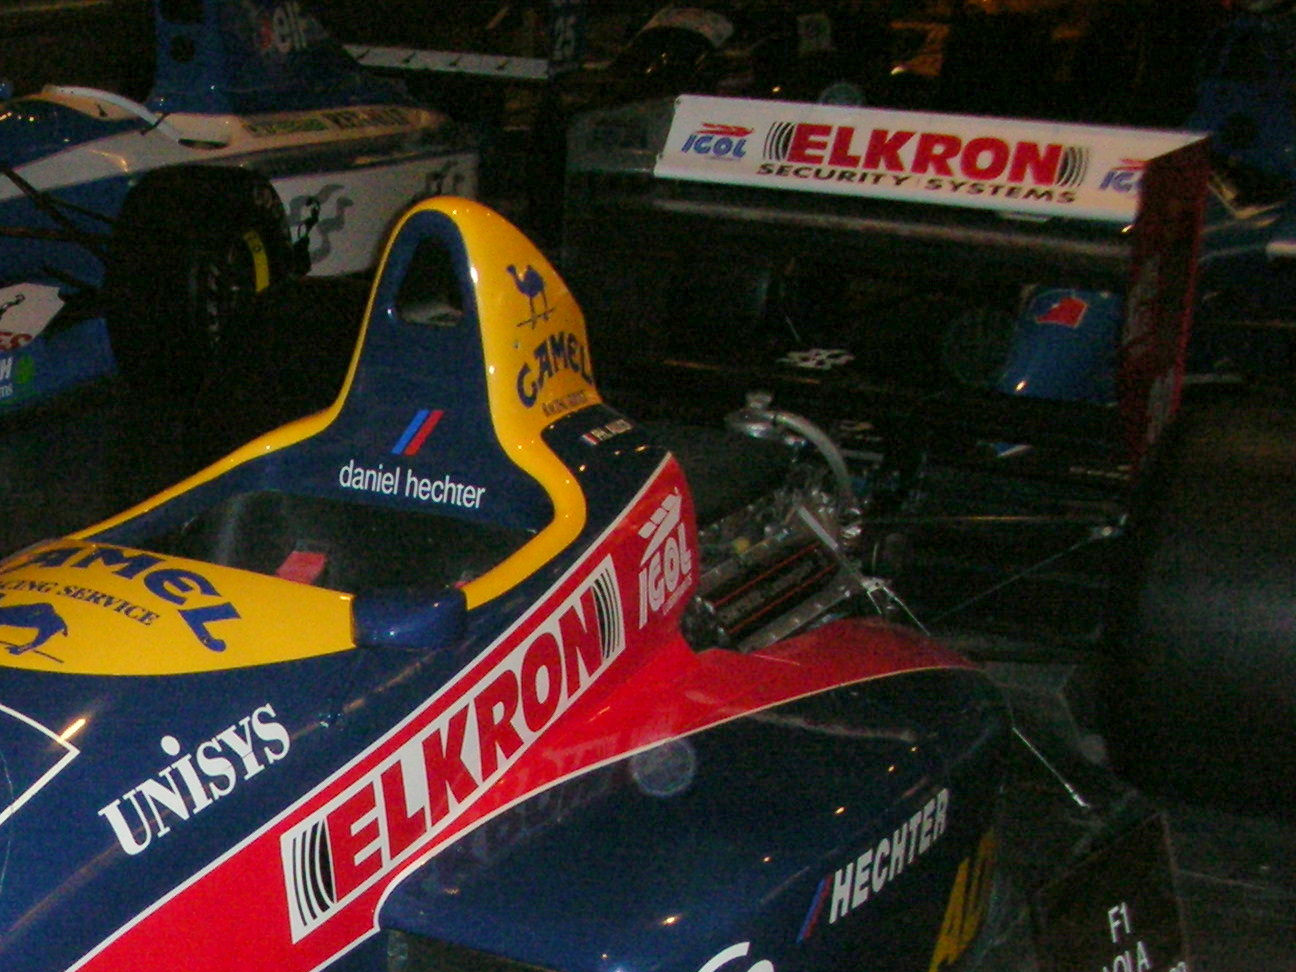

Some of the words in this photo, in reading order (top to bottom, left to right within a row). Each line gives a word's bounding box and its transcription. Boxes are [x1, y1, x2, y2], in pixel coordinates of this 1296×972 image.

[681, 134, 747, 158] IGOL
[787, 123, 1065, 186] ELKRON
[757, 162, 909, 188] SECURITY
[923, 177, 1076, 205] SYSTEMS
[517, 331, 595, 408] CAMEL
[339, 459, 400, 498] daniel
[405, 463, 486, 510] hechter
[57, 583, 161, 628] SERVICE
[639, 522, 692, 630] IGOL
[99, 702, 292, 855] UNISYS
[326, 597, 604, 902] ELKRON
[828, 787, 950, 925] HECHTER
[1107, 902, 1131, 944] F1
